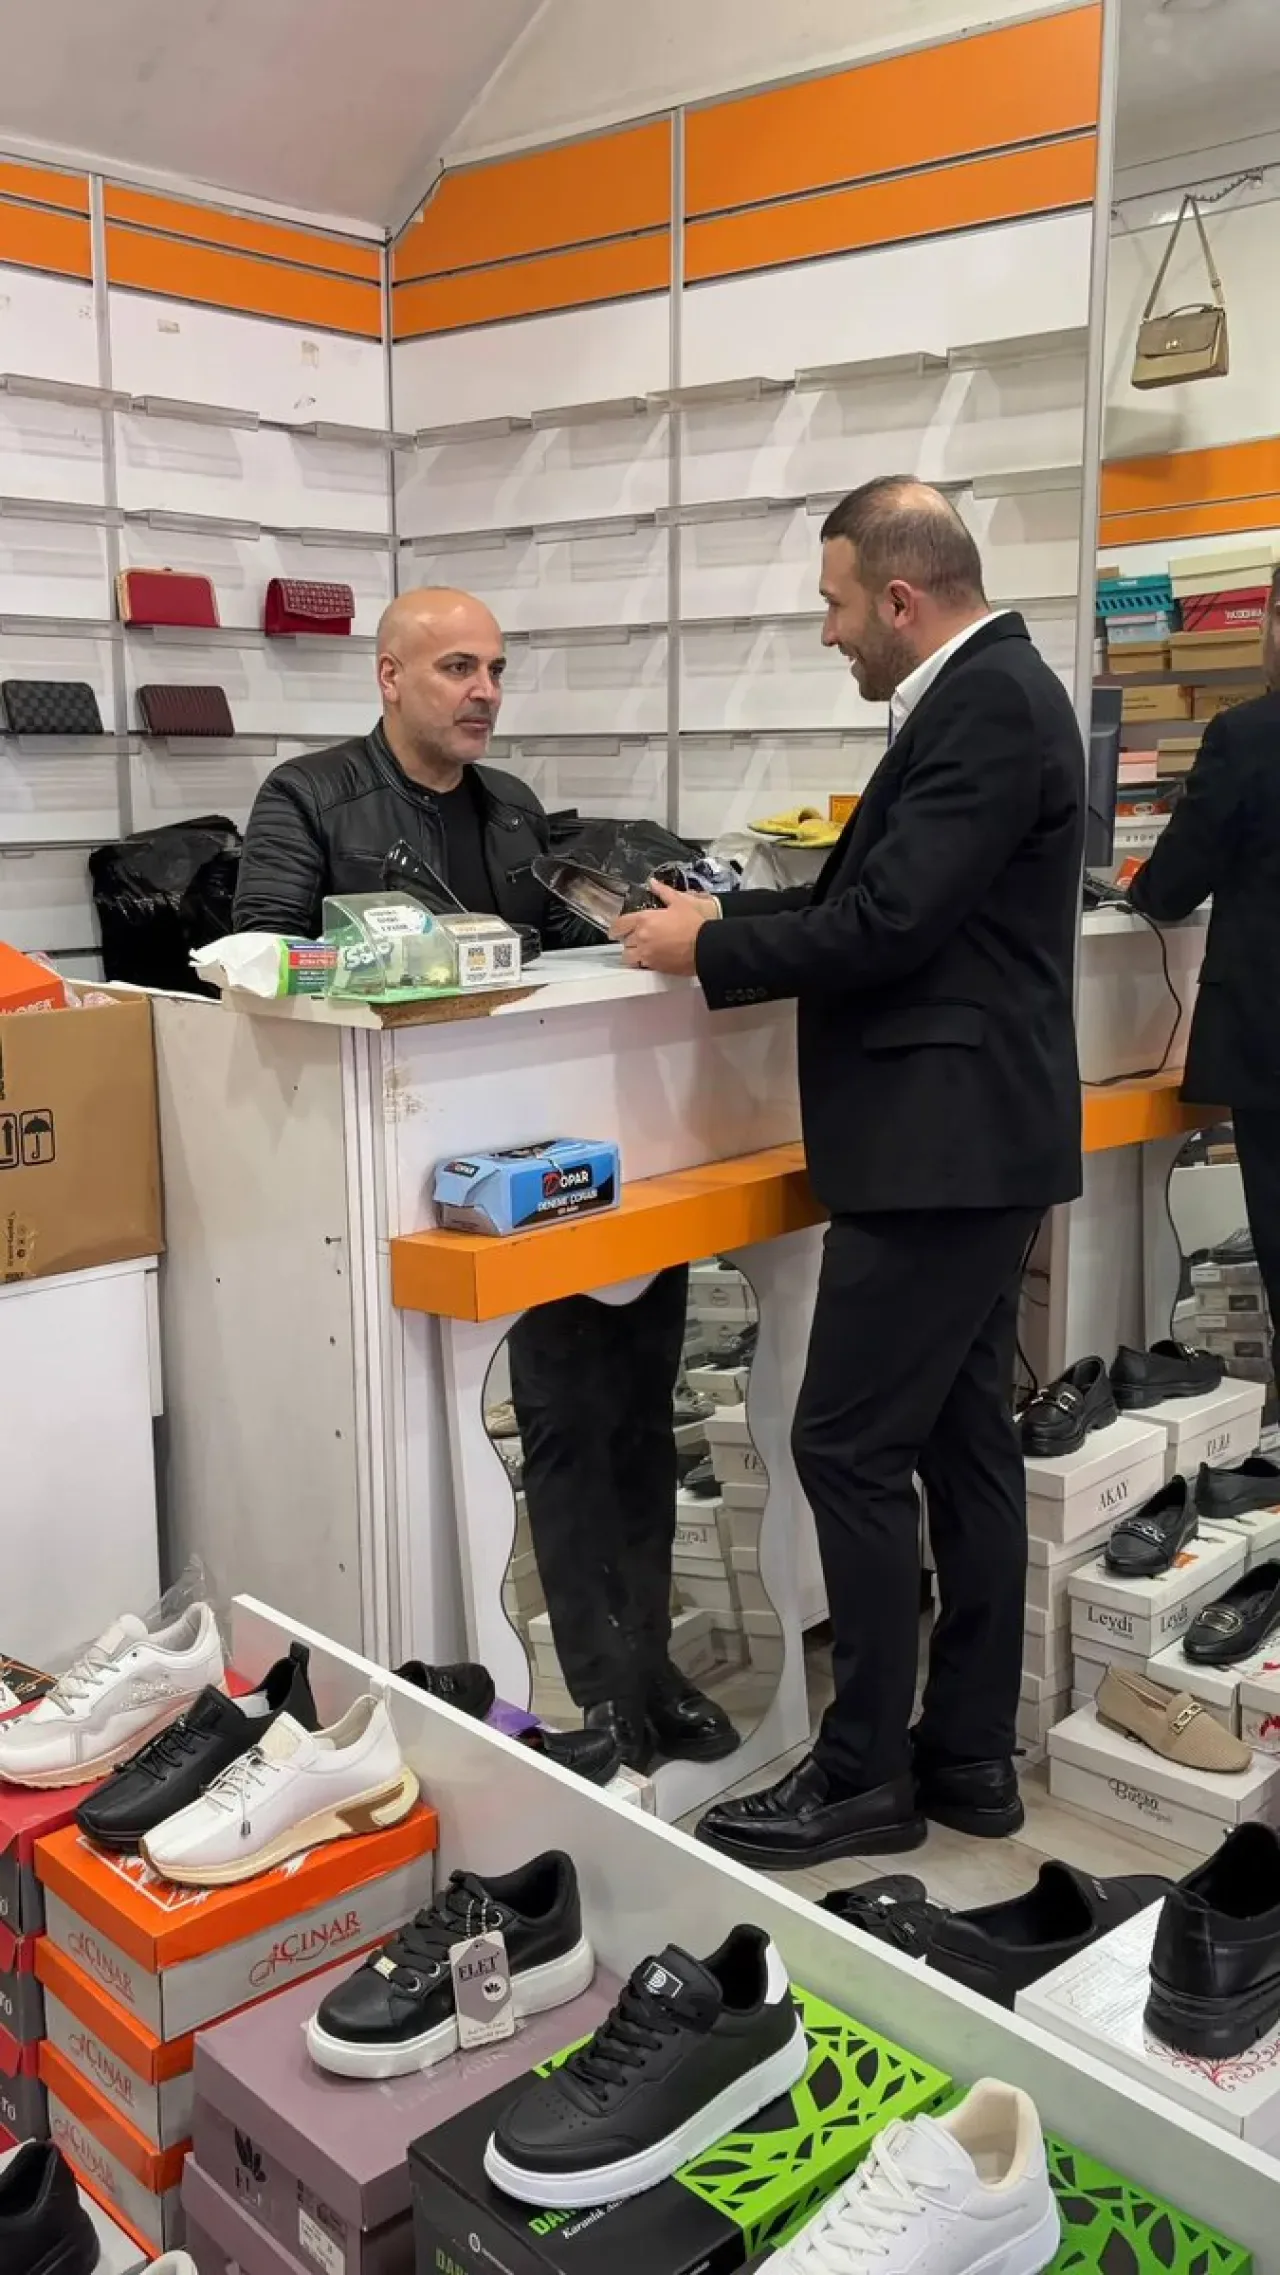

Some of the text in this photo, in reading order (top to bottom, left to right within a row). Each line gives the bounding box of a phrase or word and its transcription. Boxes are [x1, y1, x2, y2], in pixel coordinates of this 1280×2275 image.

[543, 1170, 589, 1197] DOPAR
[1099, 1479, 1129, 1509] AKAY
[1088, 1605, 1133, 1633] Leydi
